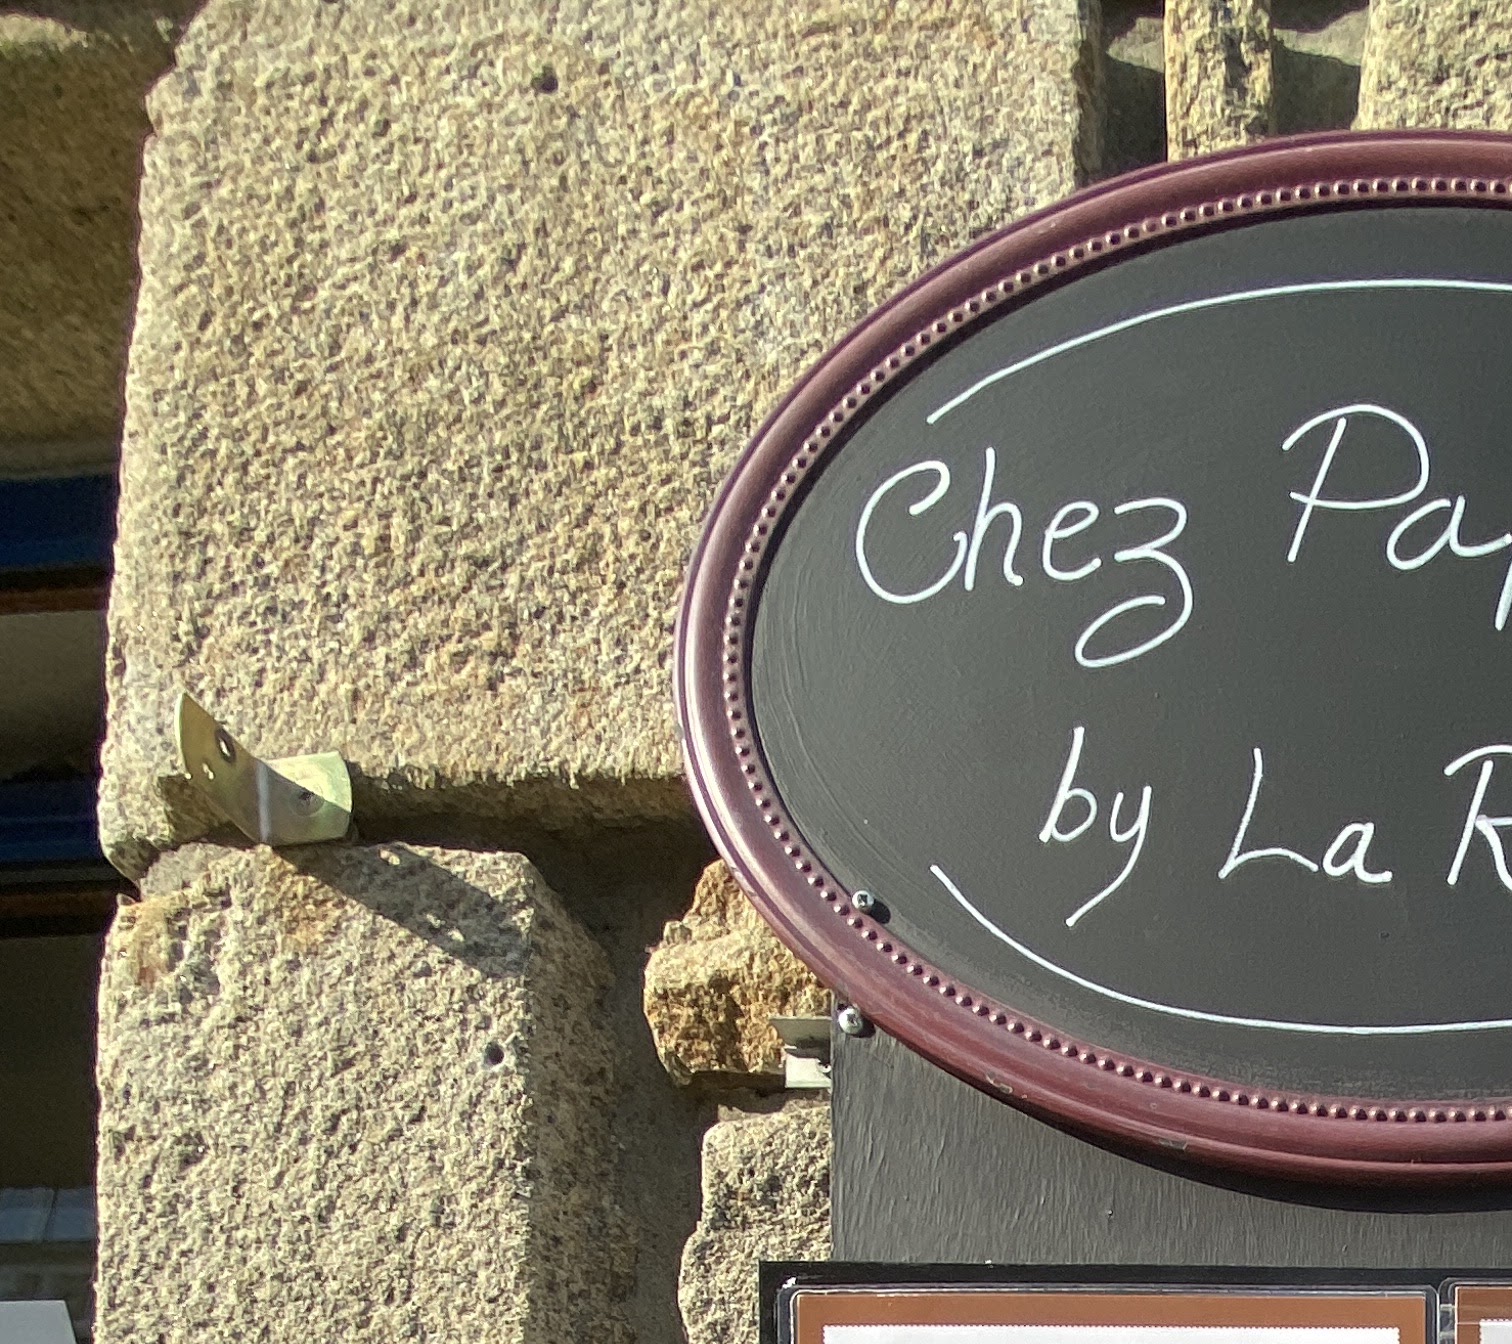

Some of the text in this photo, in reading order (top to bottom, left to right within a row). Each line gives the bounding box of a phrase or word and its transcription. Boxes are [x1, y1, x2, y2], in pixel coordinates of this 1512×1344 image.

[855, 448, 1192, 668] Chez
[1040, 728, 1154, 926] by
[1222, 748, 1392, 888] La
